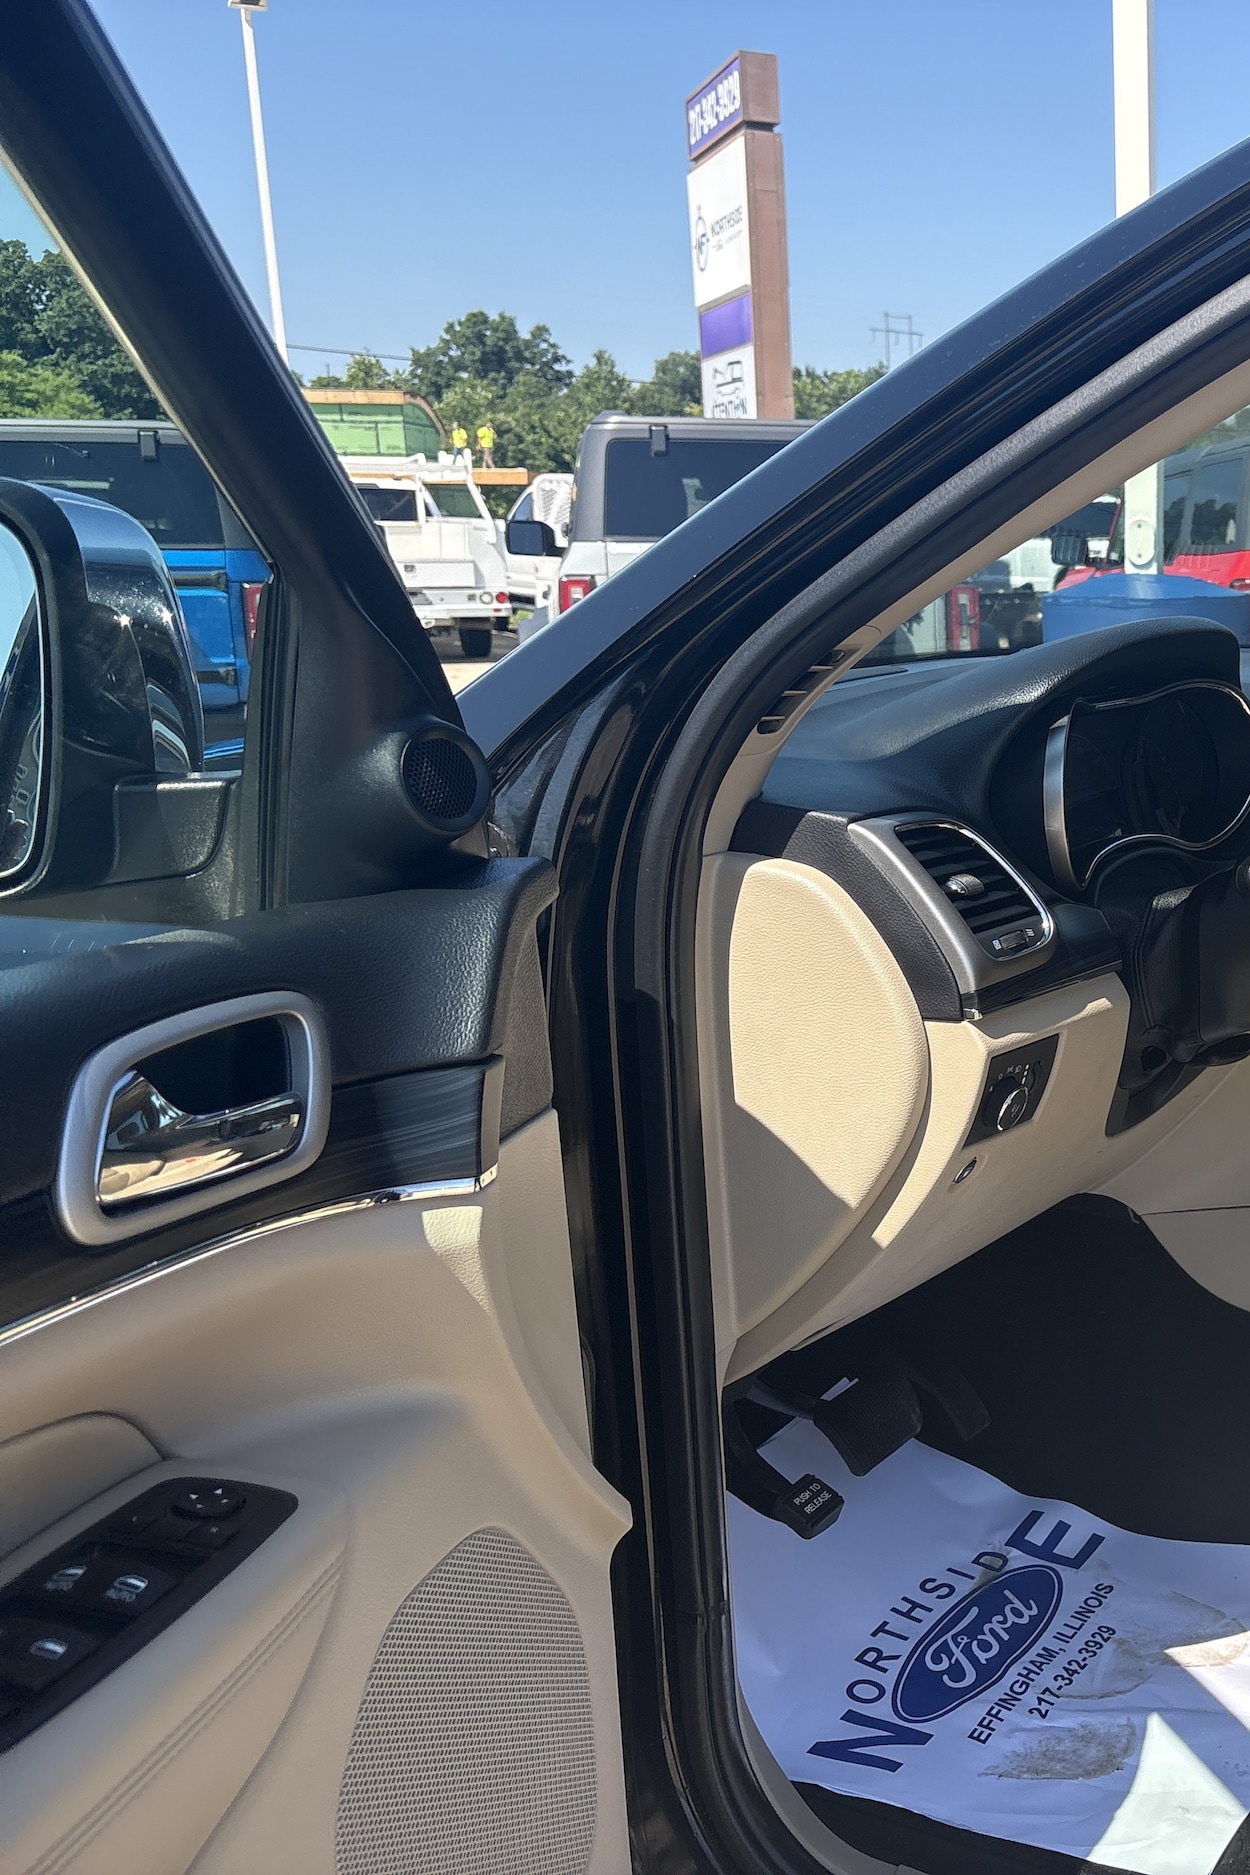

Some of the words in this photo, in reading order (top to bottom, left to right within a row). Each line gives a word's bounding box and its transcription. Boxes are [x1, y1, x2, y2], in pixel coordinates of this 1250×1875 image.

[793, 1489, 813, 1506] PUSH
[809, 1482, 822, 1492] TO
[803, 1490, 833, 1515] RELEASE
[924, 1588, 1039, 1689] Ford
[967, 1645, 1066, 1744] EFFINGHAM,
[1052, 1581, 1115, 1645] ILLINOIS
[1028, 1624, 1117, 1720] 217-342-3929
